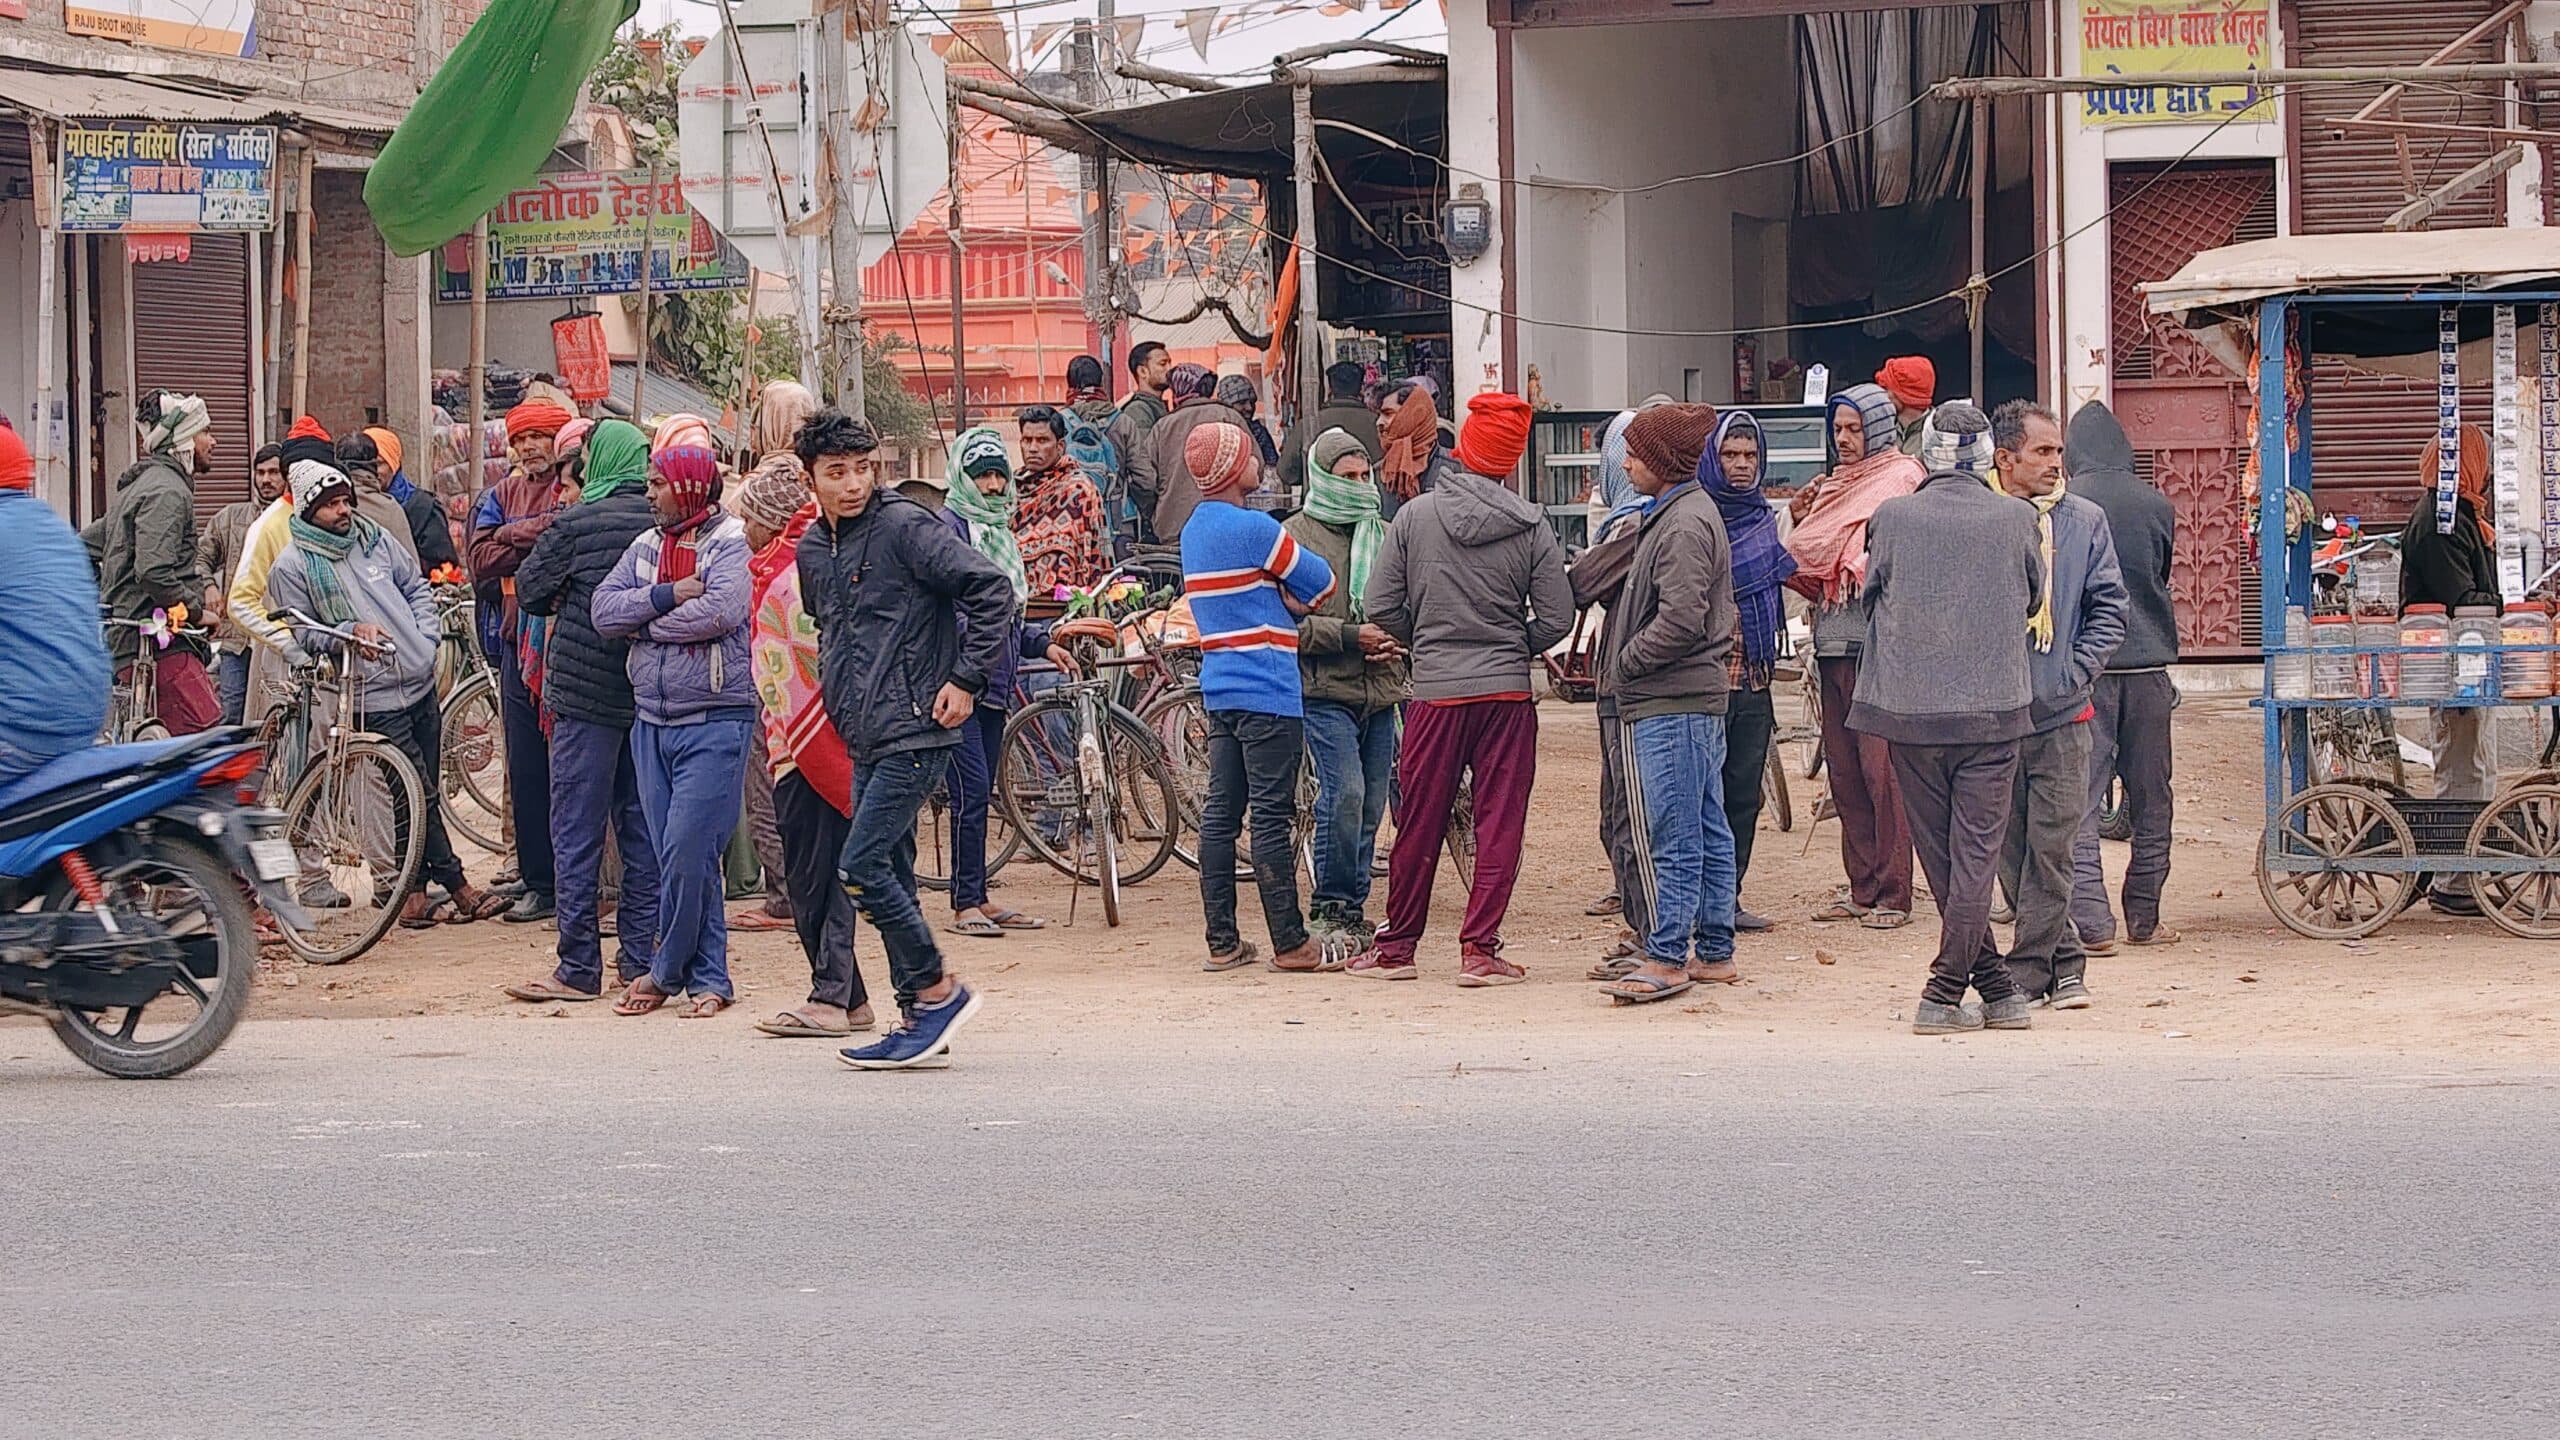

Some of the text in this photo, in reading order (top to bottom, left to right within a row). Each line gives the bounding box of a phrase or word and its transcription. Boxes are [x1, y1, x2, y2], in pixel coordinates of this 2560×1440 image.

[74, 13, 147, 37] RAJU BOOT HOUSE
[2083, 6, 2134, 49] रॉयल
[2138, 5, 2175, 48] बिग
[65, 122, 130, 162] मोबाईल
